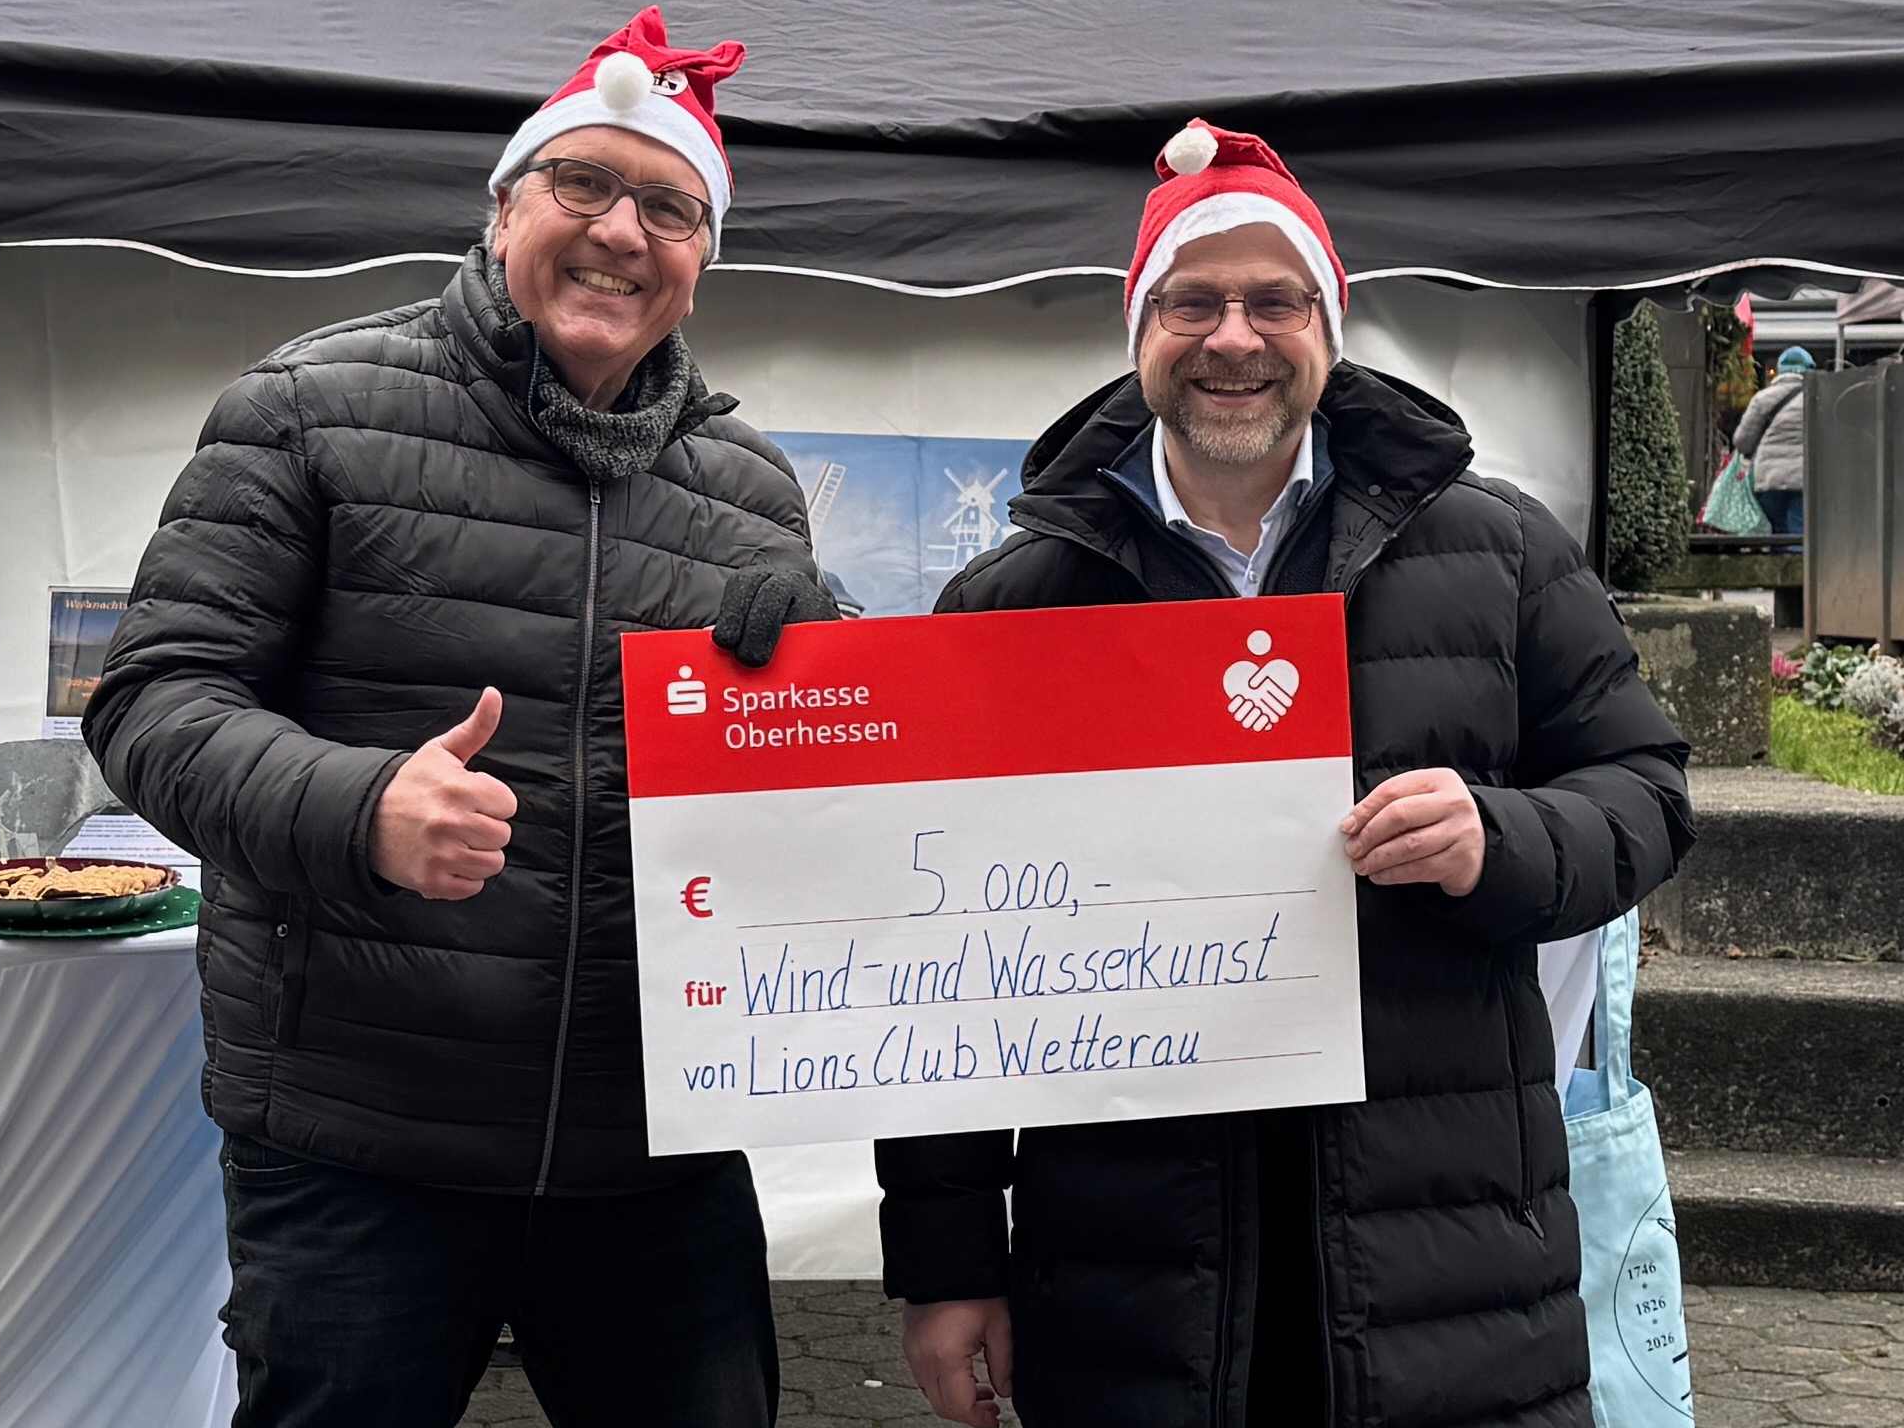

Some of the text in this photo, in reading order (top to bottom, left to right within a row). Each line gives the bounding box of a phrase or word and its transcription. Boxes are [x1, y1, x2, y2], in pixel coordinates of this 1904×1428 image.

[722, 682, 870, 718] Sparkasse
[725, 719, 898, 750] Oberhessen
[679, 875, 714, 919] €
[684, 980, 727, 1008] für
[984, 912, 1280, 999] Wasserkunst
[682, 1013, 1201, 1095] von Lions Club Wetterau
[1627, 1262, 1657, 1281] 1746
[1635, 1296, 1667, 1316] 1826
[1645, 1333, 1675, 1352] 2026
